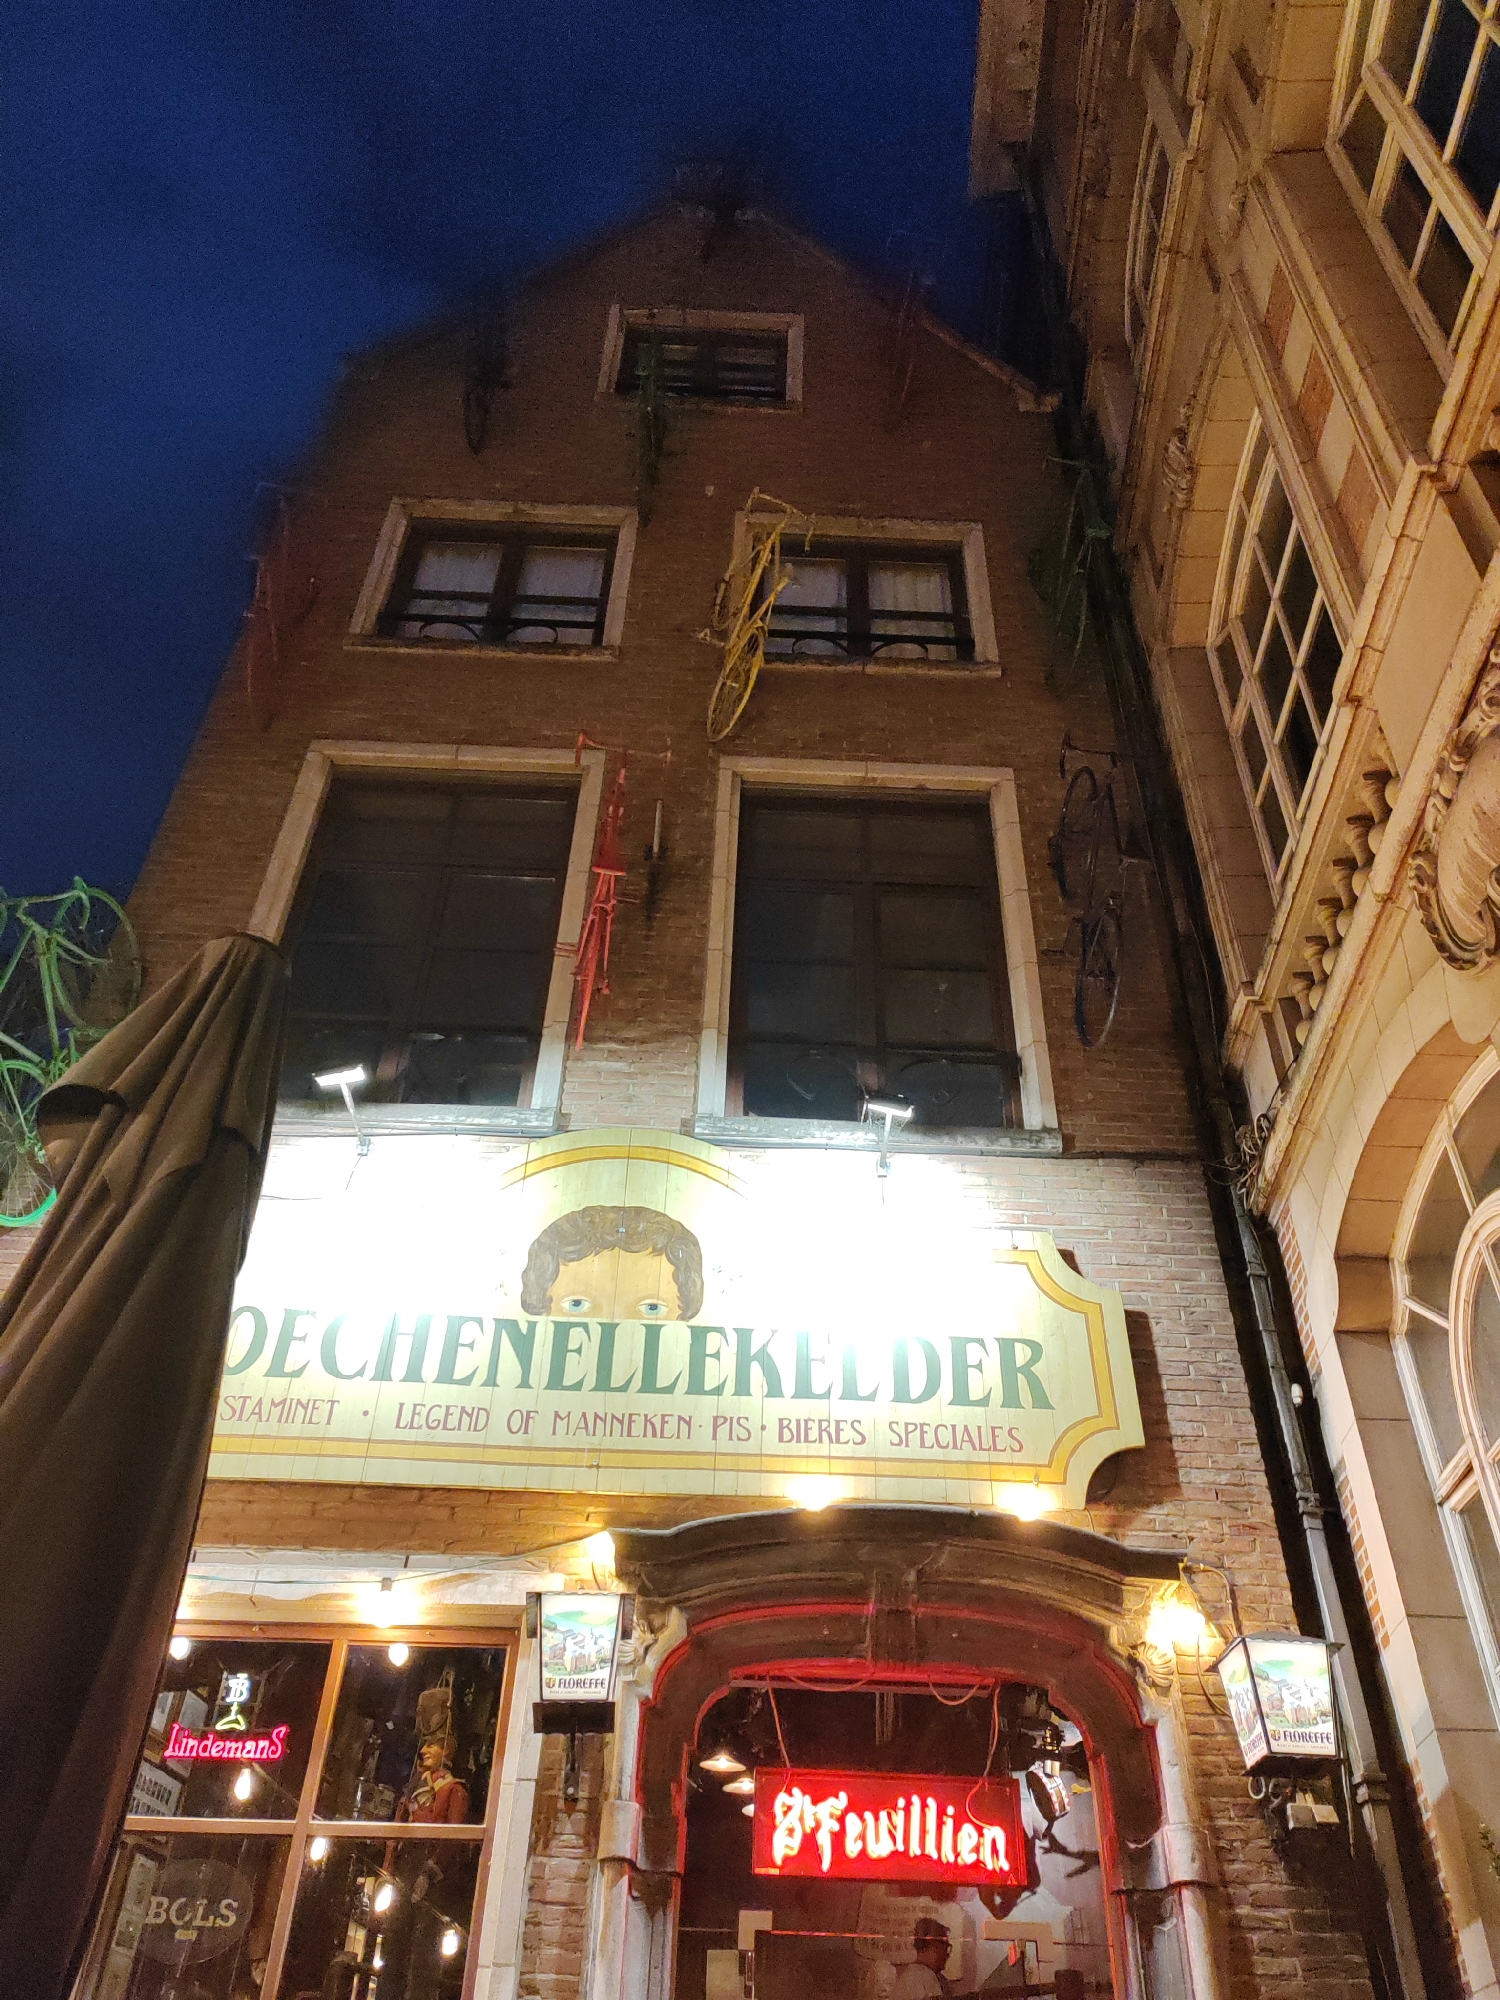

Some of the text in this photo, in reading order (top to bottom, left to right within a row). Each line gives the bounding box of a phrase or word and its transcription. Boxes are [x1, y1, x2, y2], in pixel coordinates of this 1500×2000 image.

[223, 1305, 1056, 1410] OECHENELLEKELDER
[219, 1395, 340, 1426] STAMINET
[394, 1402, 490, 1432] LEGEND
[506, 1409, 539, 1435] OF
[552, 1411, 692, 1440] MANNEKEN
[711, 1414, 752, 1442] PIS
[557, 1677, 606, 1690] FLOREFFE
[1283, 1729, 1334, 1745] FLOREFFE
[815, 1790, 1010, 1873] Feuillien
[145, 1895, 239, 1928] BOLS
